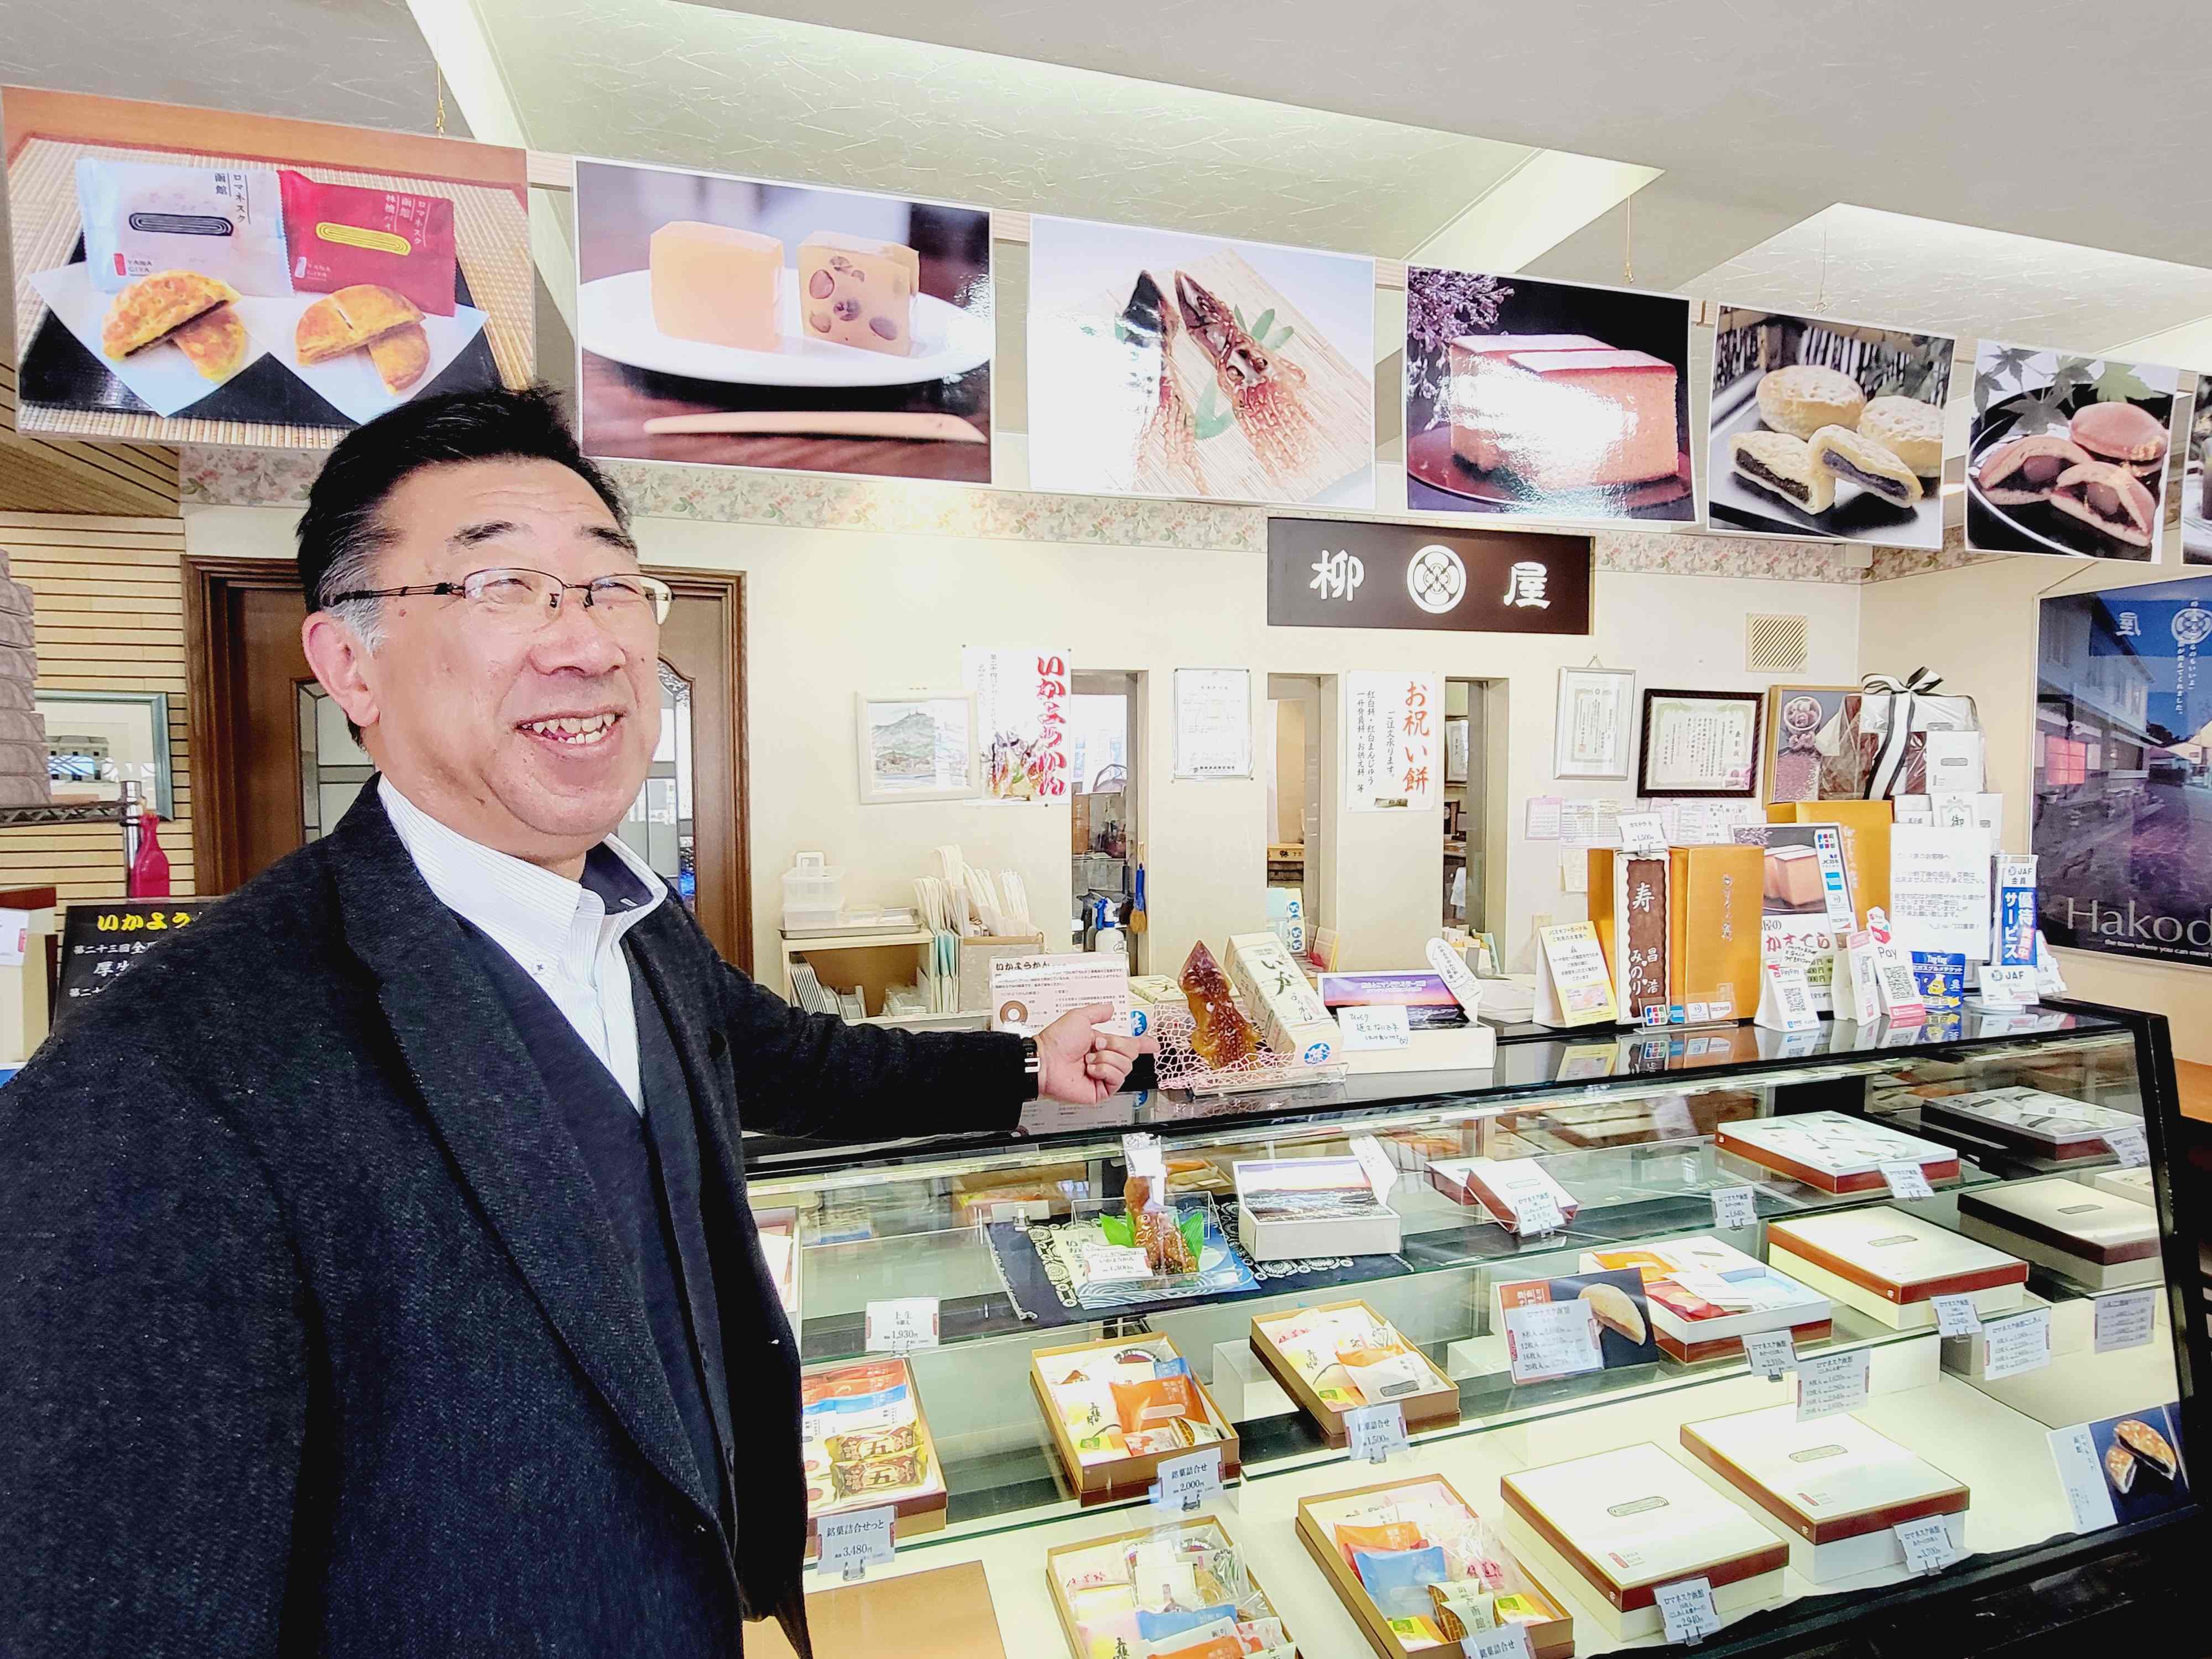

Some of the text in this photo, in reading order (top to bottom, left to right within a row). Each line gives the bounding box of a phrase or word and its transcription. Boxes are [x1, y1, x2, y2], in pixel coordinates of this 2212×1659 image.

[233, 174, 246, 222] ロマネスク
[414, 201, 426, 244] ロマネスク
[1310, 549, 1551, 609] 柳 屋
[1402, 680, 1430, 795] お祝い餅
[1632, 881, 1655, 912] 寿
[2004, 891, 2018, 959] サービス
[1630, 949, 1643, 995] みのり
[1877, 946, 1897, 960] Pay
[2005, 971, 2025, 980] JAF
